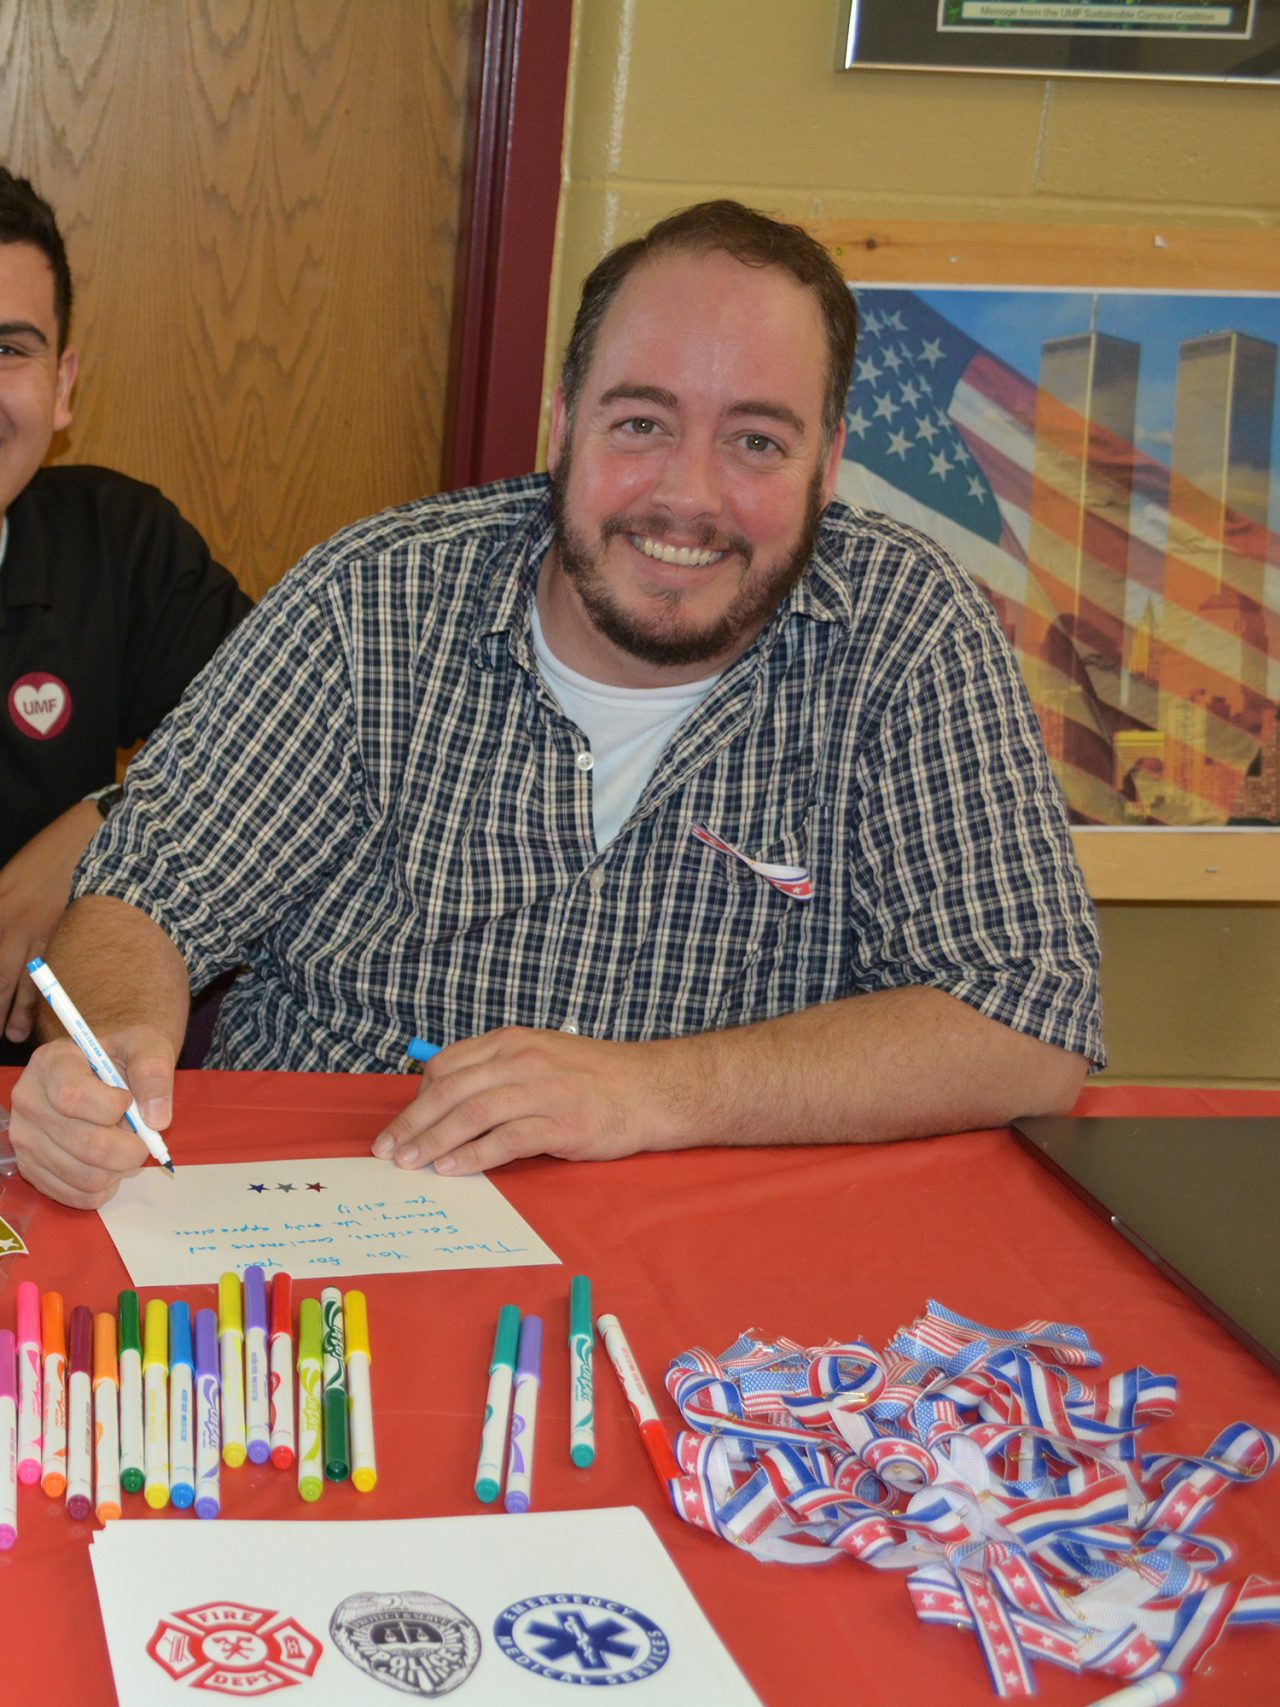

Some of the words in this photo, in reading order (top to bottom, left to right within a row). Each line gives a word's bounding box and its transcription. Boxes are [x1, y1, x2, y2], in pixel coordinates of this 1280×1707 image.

[1021, 7, 1041, 17] from
[1043, 7, 1058, 17] the
[1060, 8, 1084, 18] UMF
[23, 699, 57, 715] UMF
[503, 1593, 635, 1622] EMERGENCY
[197, 1610, 254, 1623] FIRE
[370, 1648, 461, 1672] POLICE
[497, 1635, 591, 1685] MEDICAL
[605, 1630, 666, 1685] SERVICES
[213, 1672, 274, 1687] DEPT
